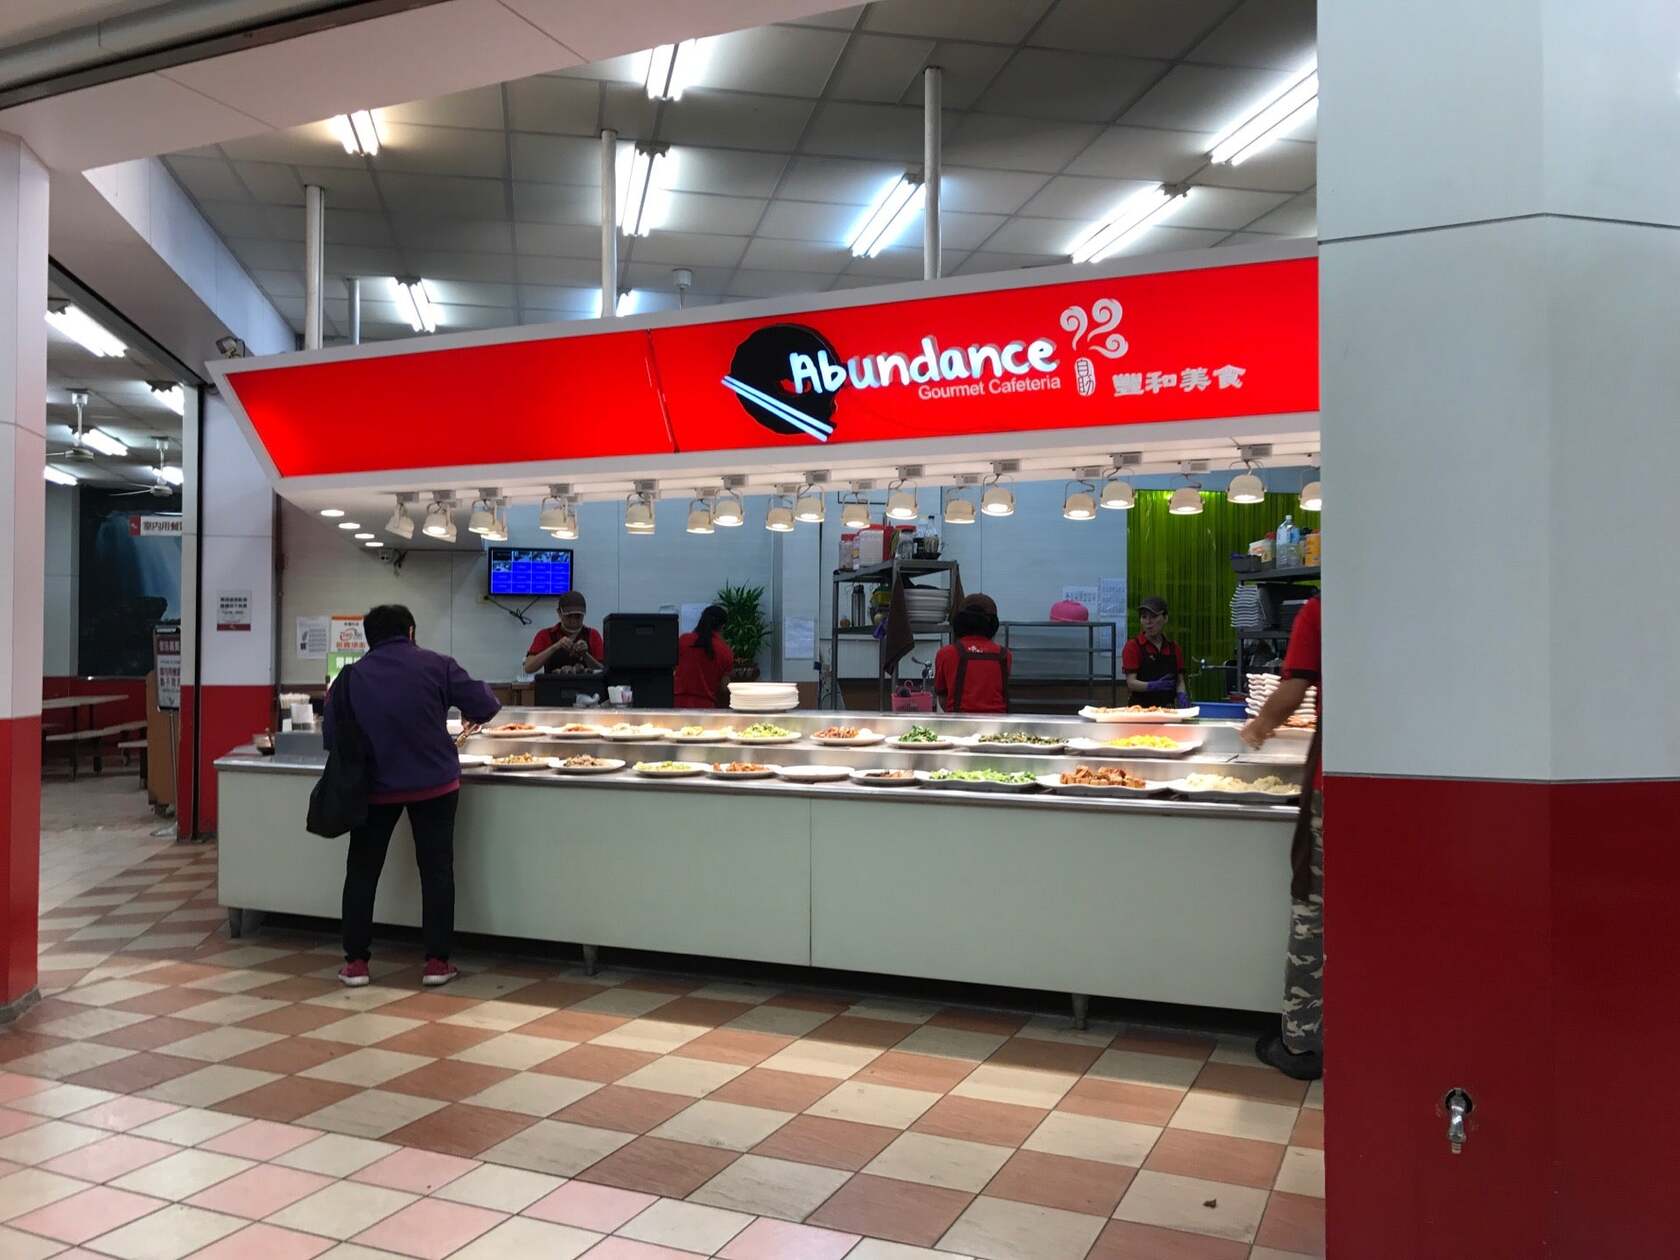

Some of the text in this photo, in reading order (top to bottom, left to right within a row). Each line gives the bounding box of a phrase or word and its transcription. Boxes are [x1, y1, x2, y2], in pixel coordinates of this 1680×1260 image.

[789, 335, 1058, 394] Abundance
[918, 374, 1061, 401] Gourmet Cafeteria
